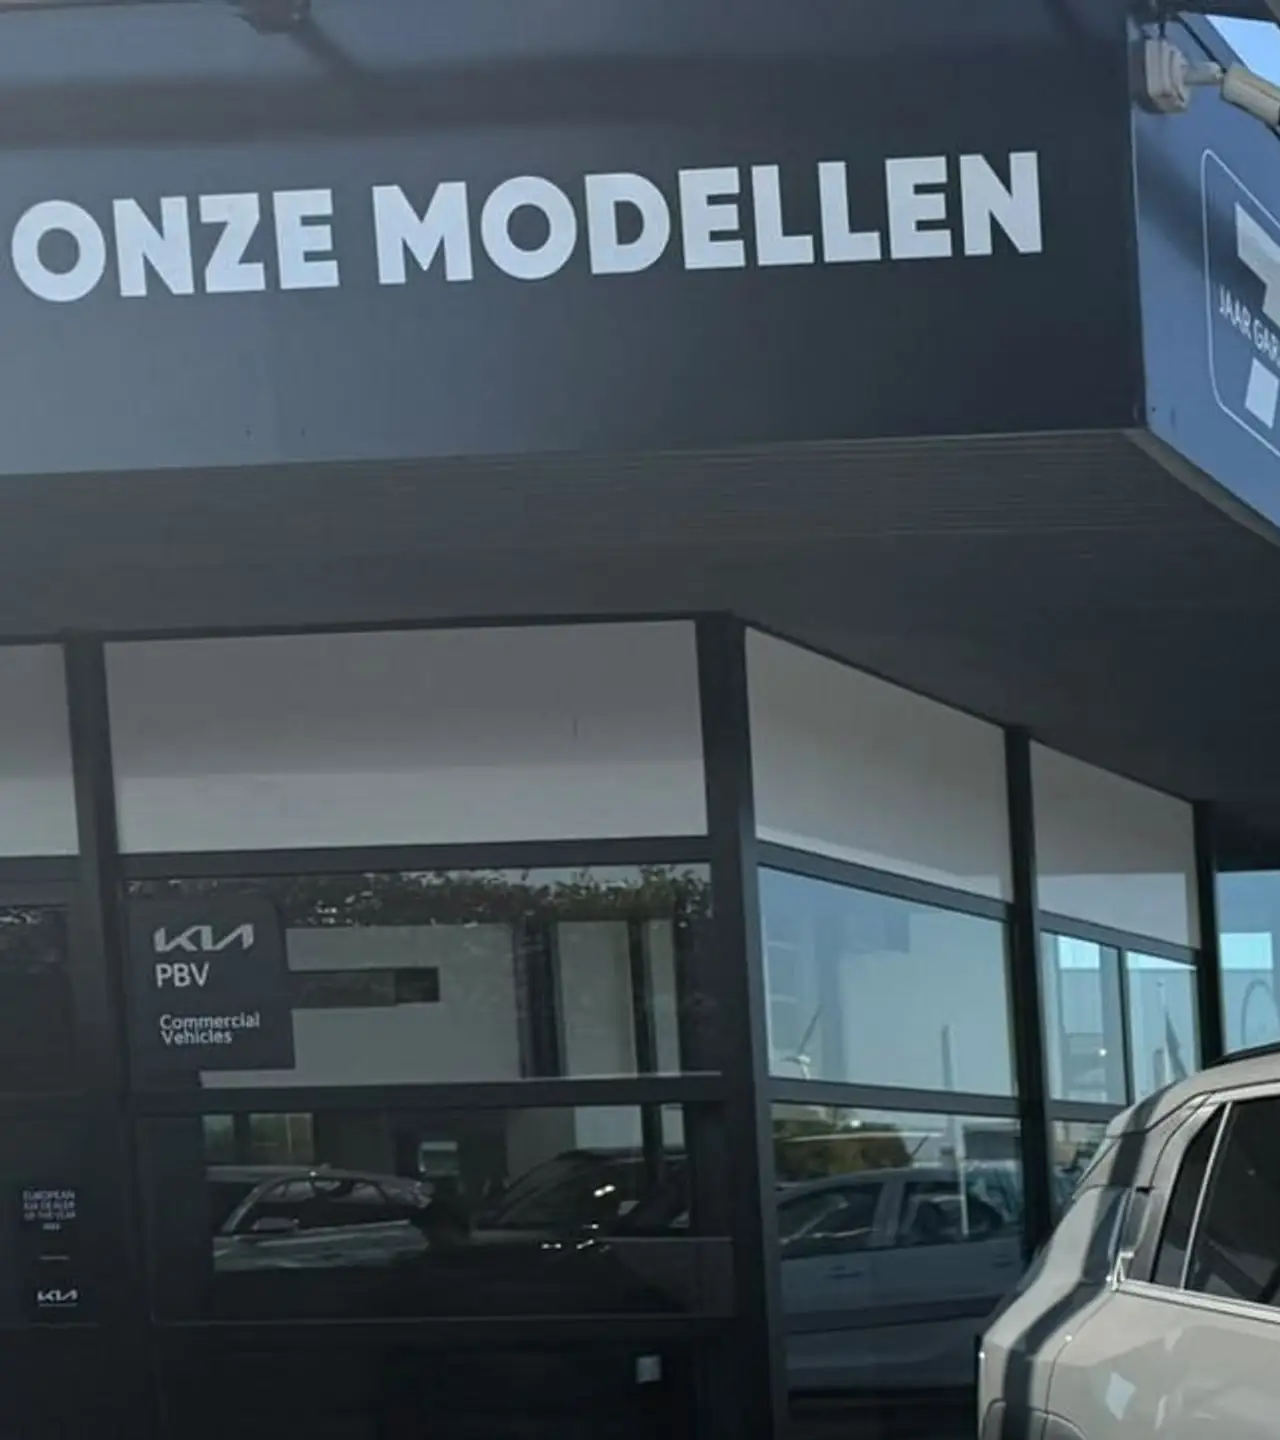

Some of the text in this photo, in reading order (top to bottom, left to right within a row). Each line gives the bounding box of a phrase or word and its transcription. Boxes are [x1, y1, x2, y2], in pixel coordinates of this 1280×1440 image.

[10, 151, 1043, 303] ONZE MODELLEN
[1219, 284, 1252, 341] JAAR
[153, 923, 255, 953] KIA
[155, 961, 210, 989] PBV
[159, 1011, 262, 1030] Commercial
[160, 1029, 234, 1046] Vehicles
[37, 1289, 79, 1303] KIA
